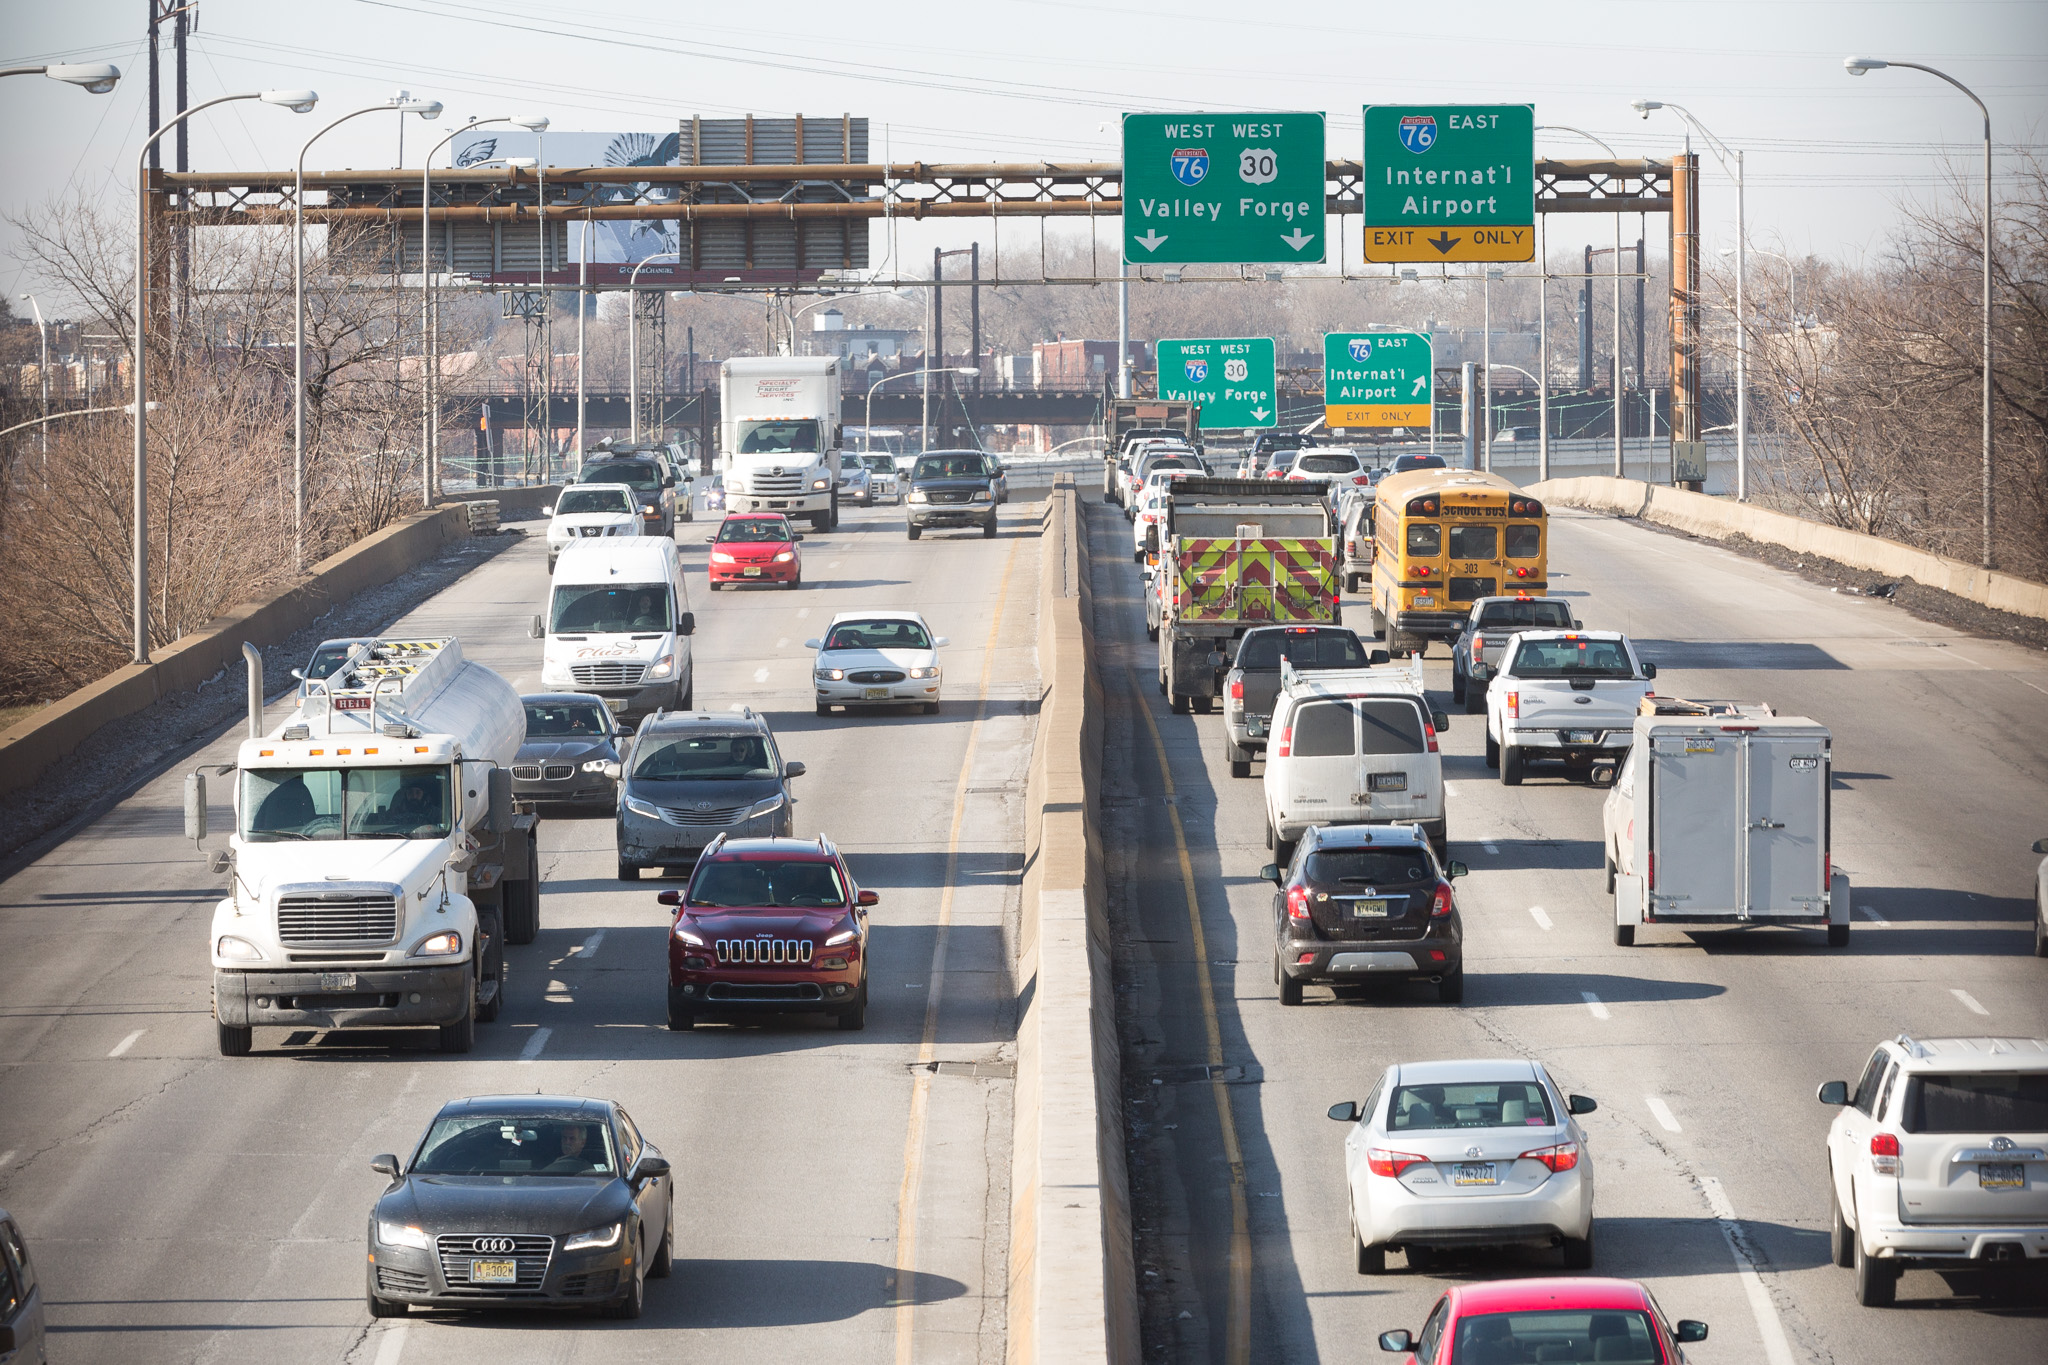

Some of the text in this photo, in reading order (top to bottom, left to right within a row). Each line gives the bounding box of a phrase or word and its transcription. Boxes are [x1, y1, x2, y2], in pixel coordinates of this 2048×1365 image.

[1449, 115, 1499, 129] EAST
[1164, 123, 1283, 138] WEST WEST
[1402, 125, 1432, 146] 76
[1174, 155, 1273, 178] 76 30
[1386, 164, 1511, 185] Internat'l
[1139, 198, 1310, 222] Valley Forge
[1401, 195, 1497, 218] Airport
[1373, 231, 1524, 245] EXIT ONLY
[1180, 344, 1251, 355] WEST WEST
[1351, 338, 1408, 358] 76 EAST
[1187, 364, 1246, 379] 76 30
[1167, 388, 1268, 404] Valley Forge
[1340, 386, 1397, 400] Airport
[1346, 411, 1412, 421] EXIT ONLY
[1443, 505, 1505, 517] SCHOOL BUS
[1464, 563, 1479, 574] 303
[339, 699, 368, 708] HEIL
